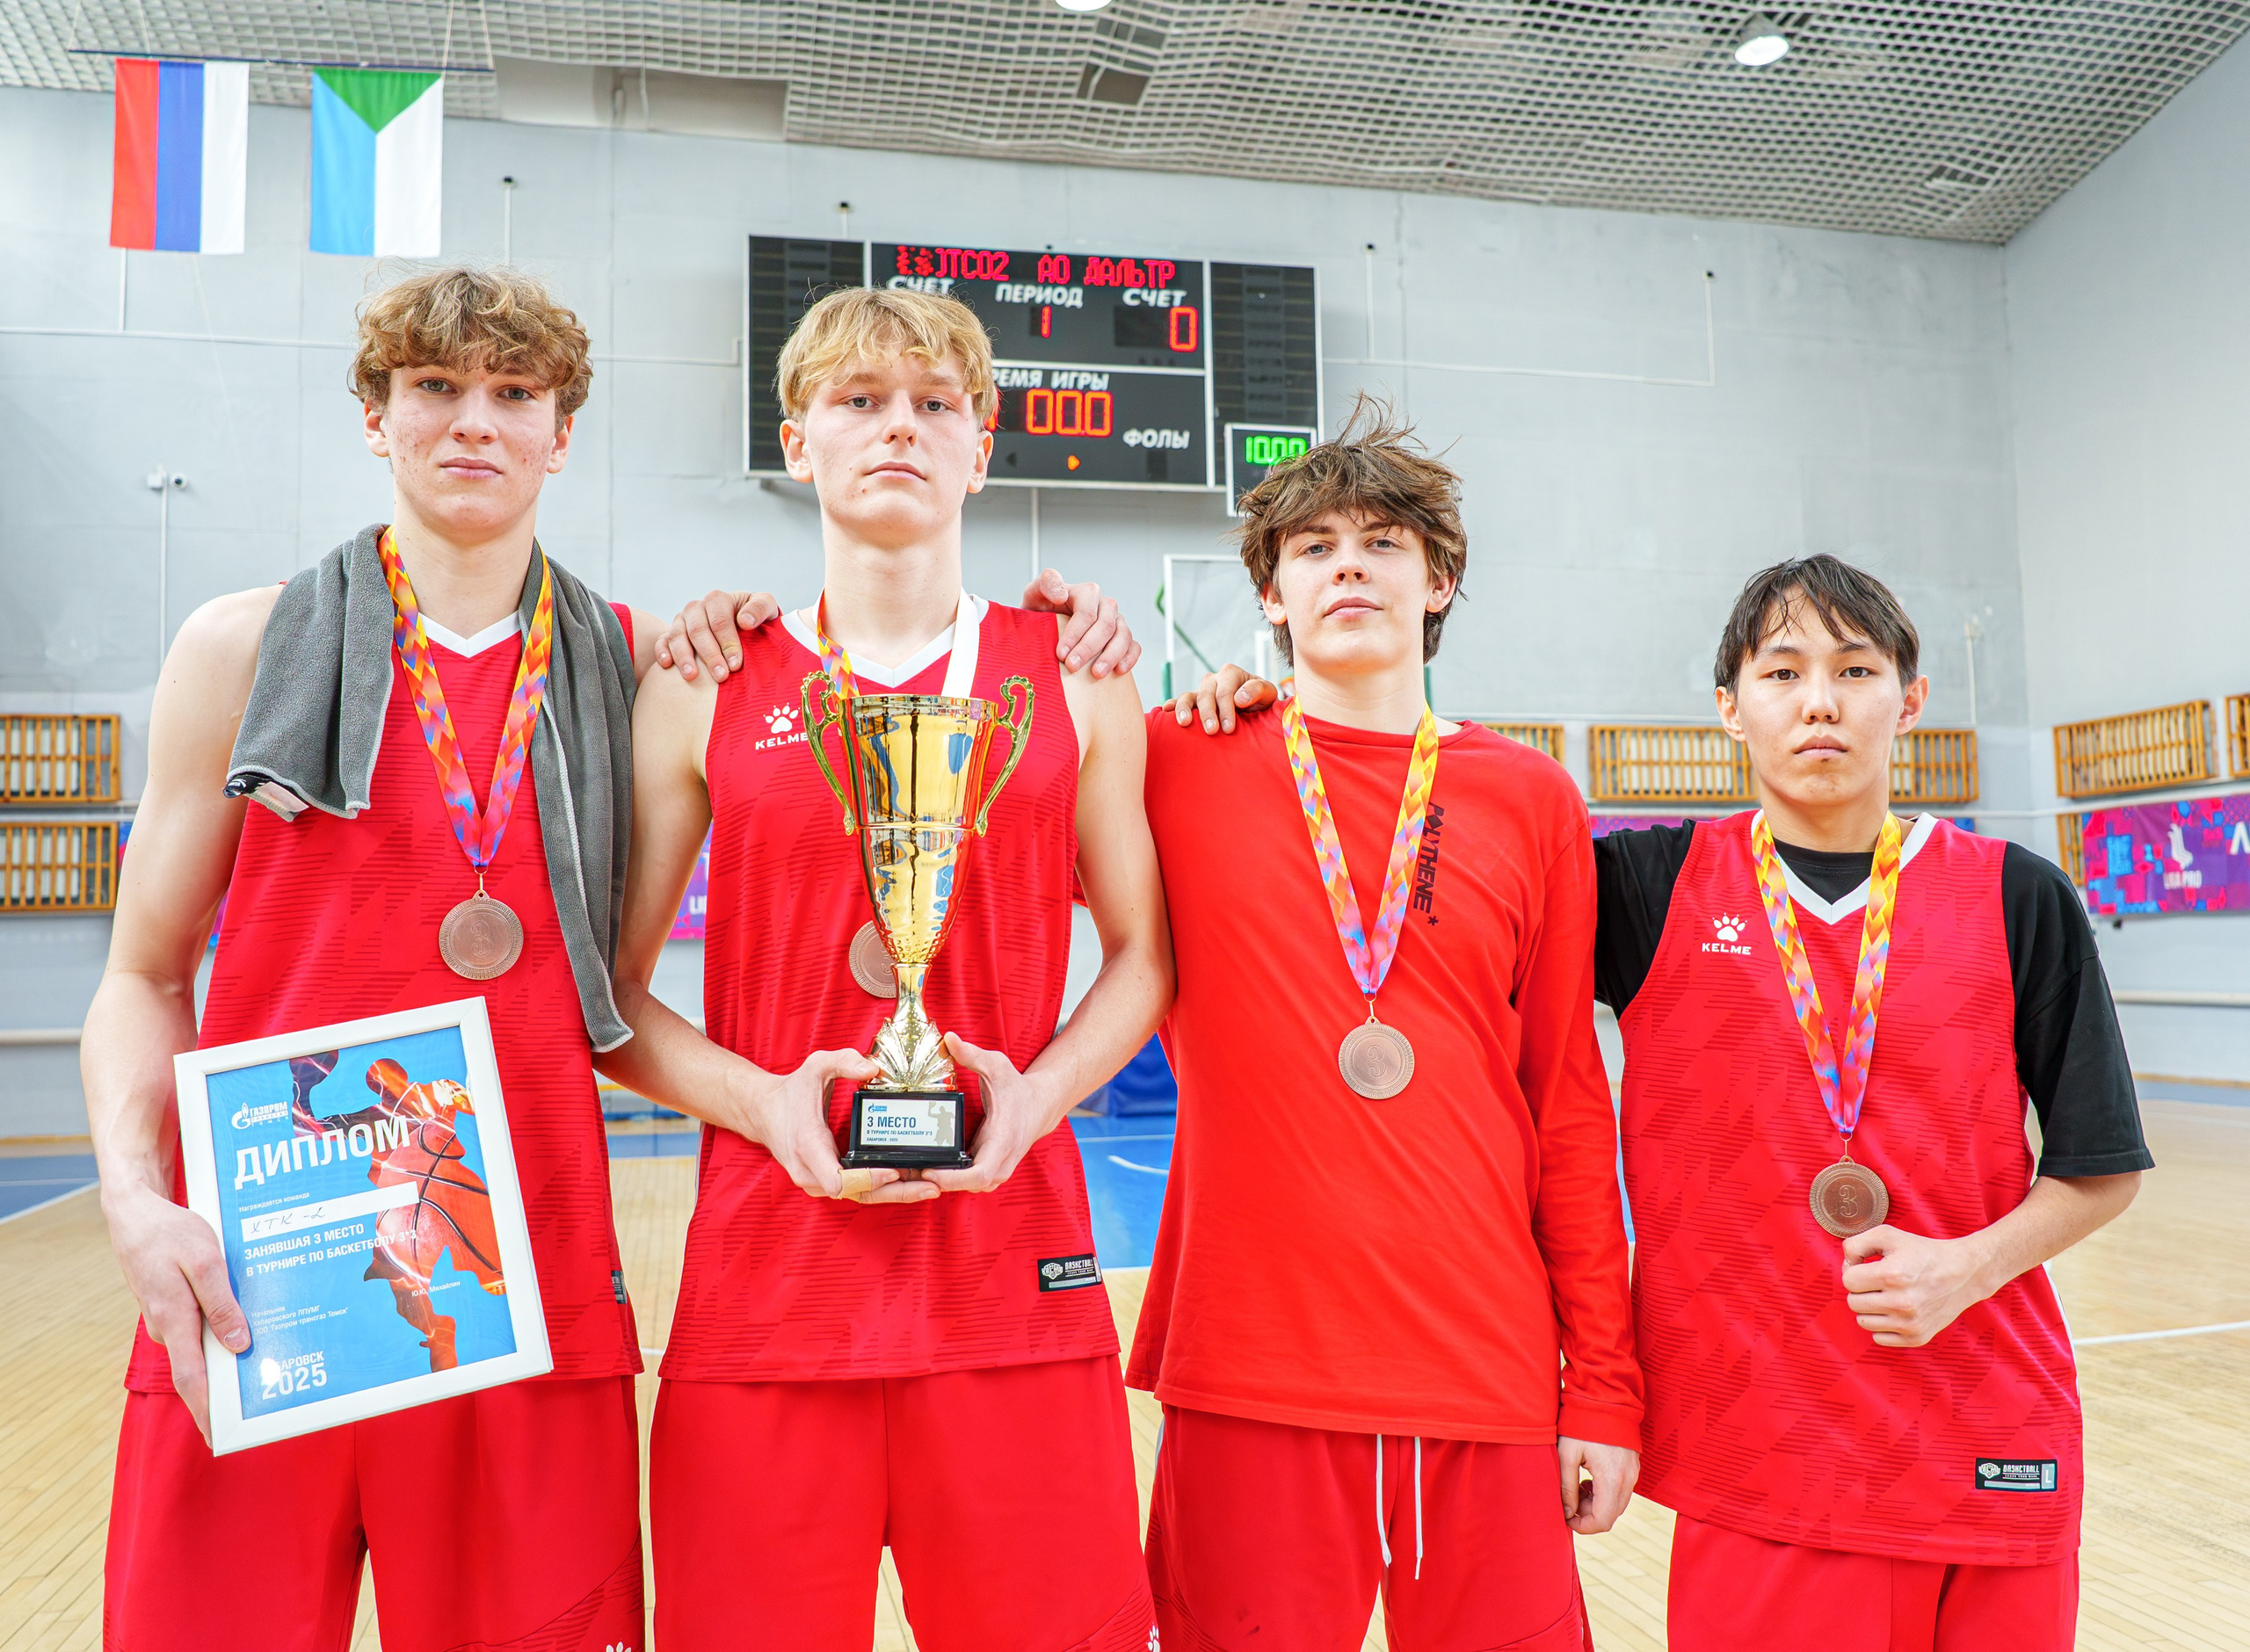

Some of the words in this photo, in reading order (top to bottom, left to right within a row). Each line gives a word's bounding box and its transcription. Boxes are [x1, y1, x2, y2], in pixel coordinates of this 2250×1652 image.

[995, 283, 1083, 308] ПЕРИОД
[1122, 287, 1187, 308] СЧЕТ
[1041, 306, 1051, 338] 1
[1169, 307, 1198, 352] 0
[991, 368, 1043, 388] РЕМЯ
[1050, 371, 1109, 391] ИГРЫ
[1122, 428, 1190, 449] ФОЛЫ
[755, 733, 809, 750] KELME
[1702, 942, 1752, 955] KELME
[250, 1101, 287, 1117] ГАЗПРОМ
[867, 1116, 874, 1127] 3
[877, 1116, 917, 1128] МЕСТО
[235, 1115, 410, 1190] ДИПЛОМ
[283, 1192, 310, 1203] команда
[244, 1235, 311, 1260] ЗАНЯВШАЯ
[314, 1233, 322, 1244] 3
[323, 1223, 365, 1243] МЕСТО
[246, 1266, 254, 1278] В
[256, 1254, 307, 1274] ТУРНИРЕ
[308, 1250, 324, 1263] ПО
[326, 1234, 396, 1259] БАСКЕТБОЛУ
[262, 1361, 327, 1400] 2025
